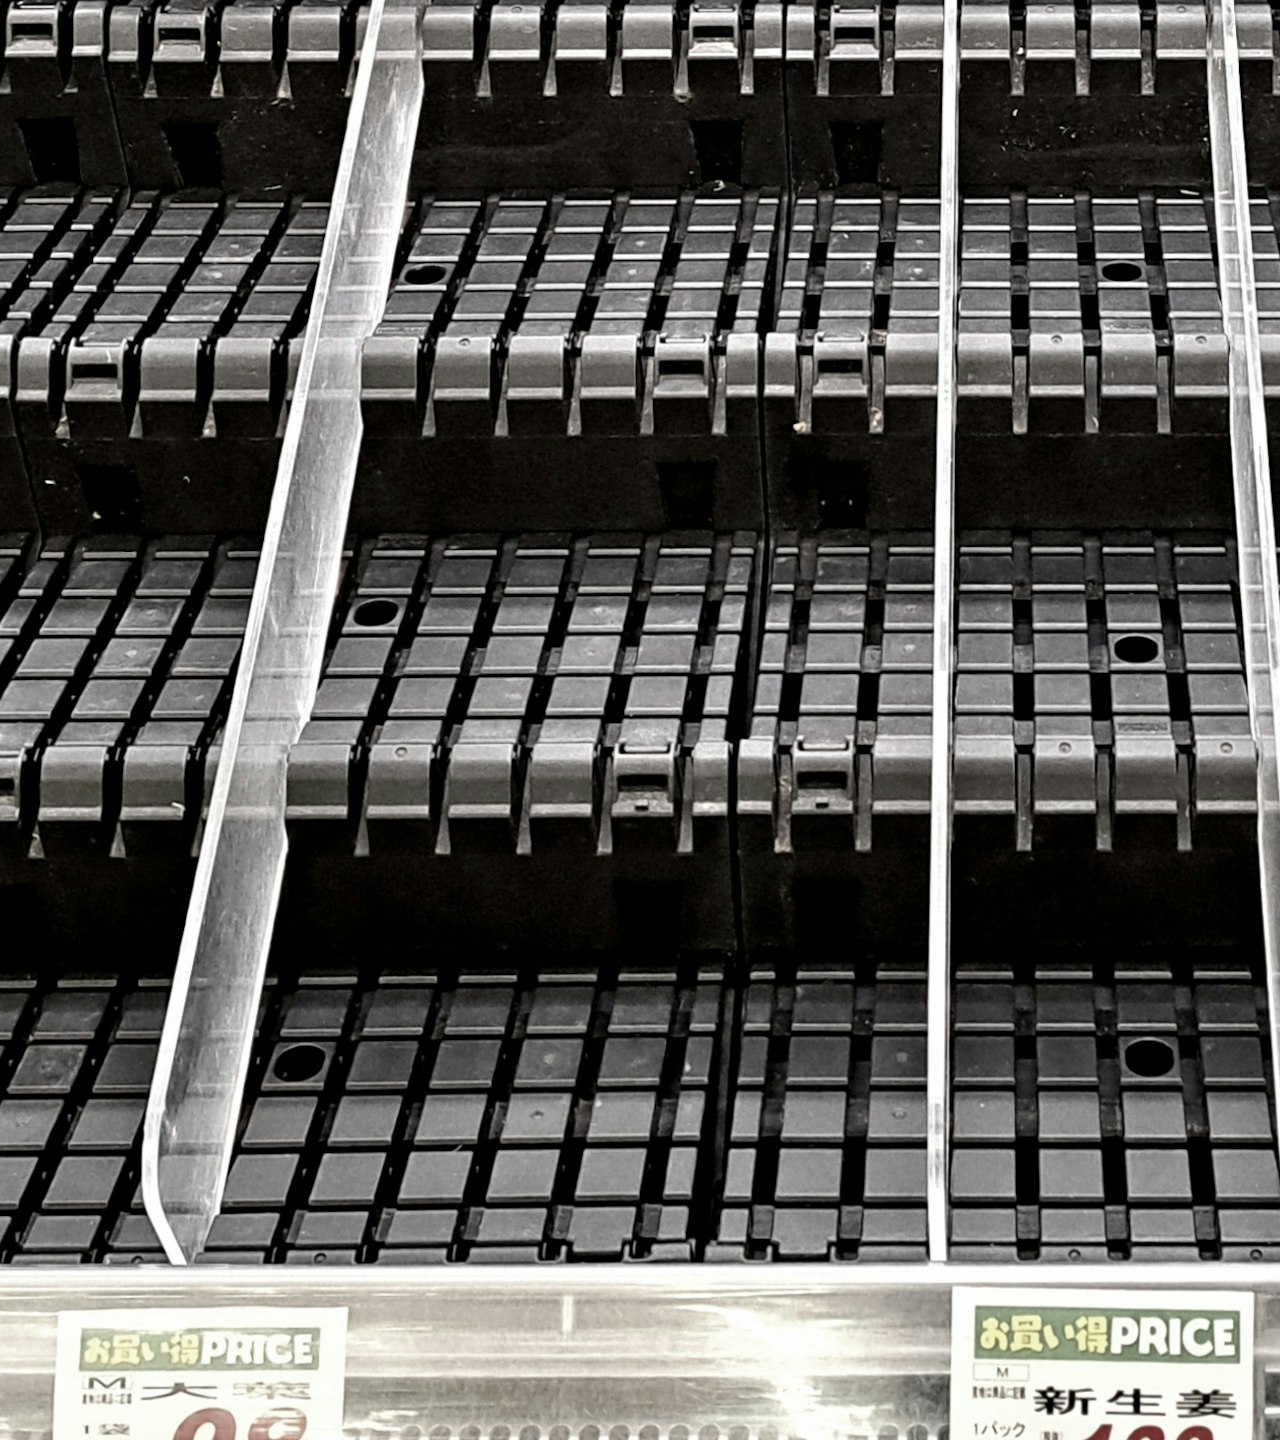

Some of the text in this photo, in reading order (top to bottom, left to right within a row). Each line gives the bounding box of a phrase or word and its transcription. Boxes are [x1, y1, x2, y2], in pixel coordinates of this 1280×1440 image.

[980, 1315, 1236, 1357] お買い得PRICE
[1033, 1386, 1237, 1419] 新生姜
